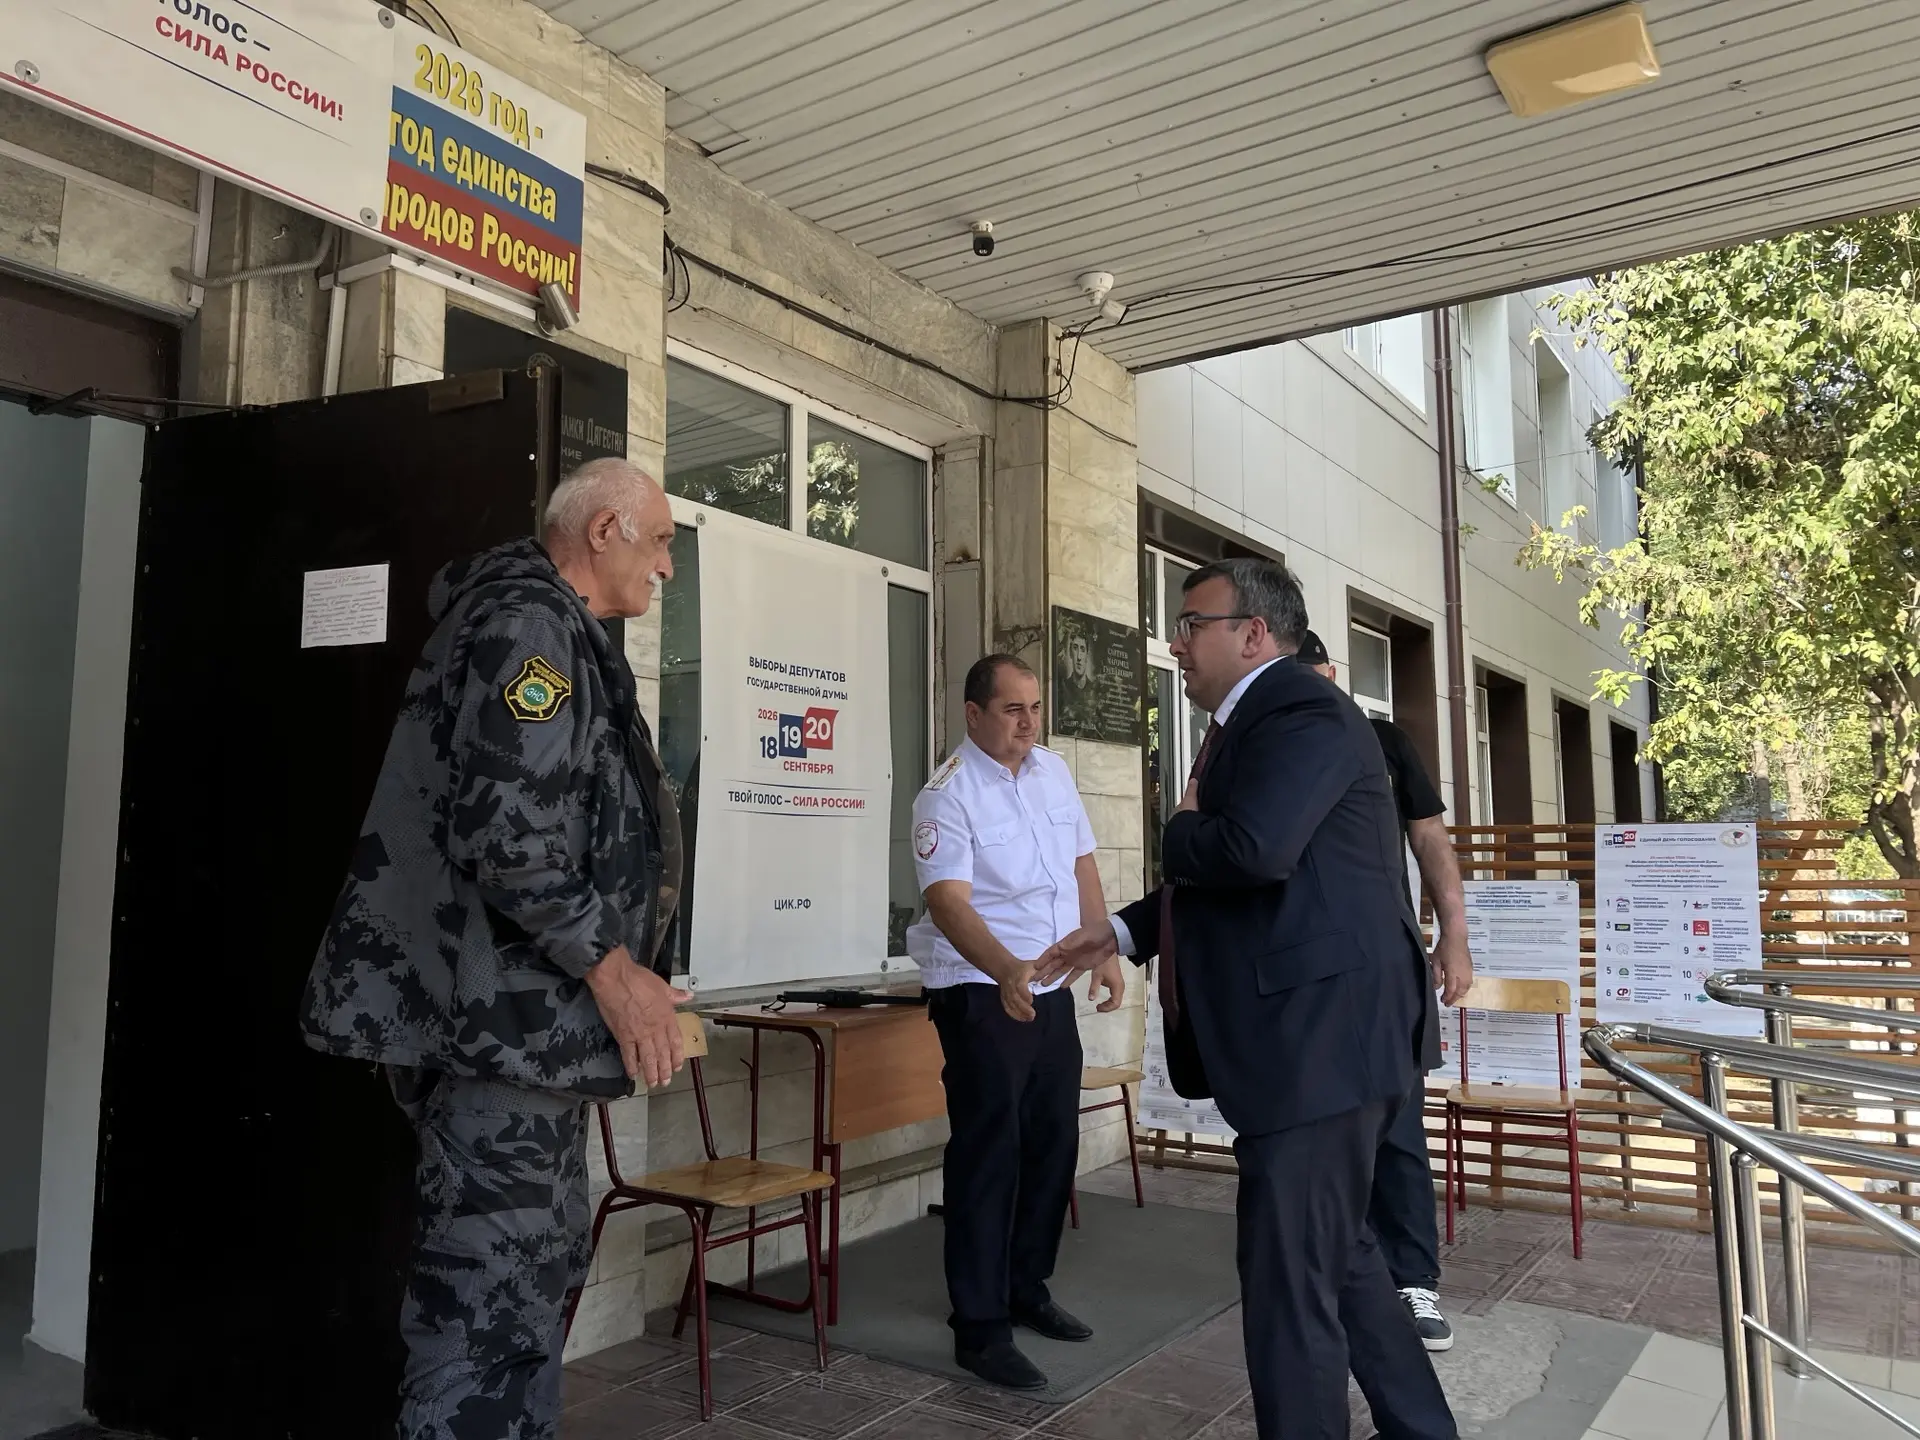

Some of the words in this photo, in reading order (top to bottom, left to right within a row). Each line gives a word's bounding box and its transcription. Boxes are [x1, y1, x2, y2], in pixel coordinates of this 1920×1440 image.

[159, 0, 248, 43] ОЛОС
[155, 16, 229, 66] СИЛА
[236, 53, 343, 121] РОССИИ!
[414, 43, 484, 117] 2026
[489, 92, 530, 150] год
[389, 110, 436, 172] год
[442, 137, 557, 223] единства
[481, 212, 576, 296] России!
[749, 656, 787, 674] ВЫБОРЫ
[789, 665, 846, 683] ДЕПУТАТОВ
[746, 676, 820, 697] ГОСУДАРСТВЕННОЙ
[822, 690, 848, 701] ДУМЫ
[758, 708, 778, 721] 2026
[760, 736, 778, 759] 18
[781, 726, 801, 749] 19
[805, 716, 831, 740] 20
[783, 761, 834, 774] СЕНТЯБРЯ
[728, 790, 752, 802] ТВОЙ
[753, 793, 783, 806] ГОЛОС
[792, 796, 819, 808] СИЛА
[821, 797, 866, 810] РОССИИ!
[774, 898, 812, 912] ЦИК.РФ
[1682, 900, 1687, 908] 7
[1684, 946, 1689, 954] 9
